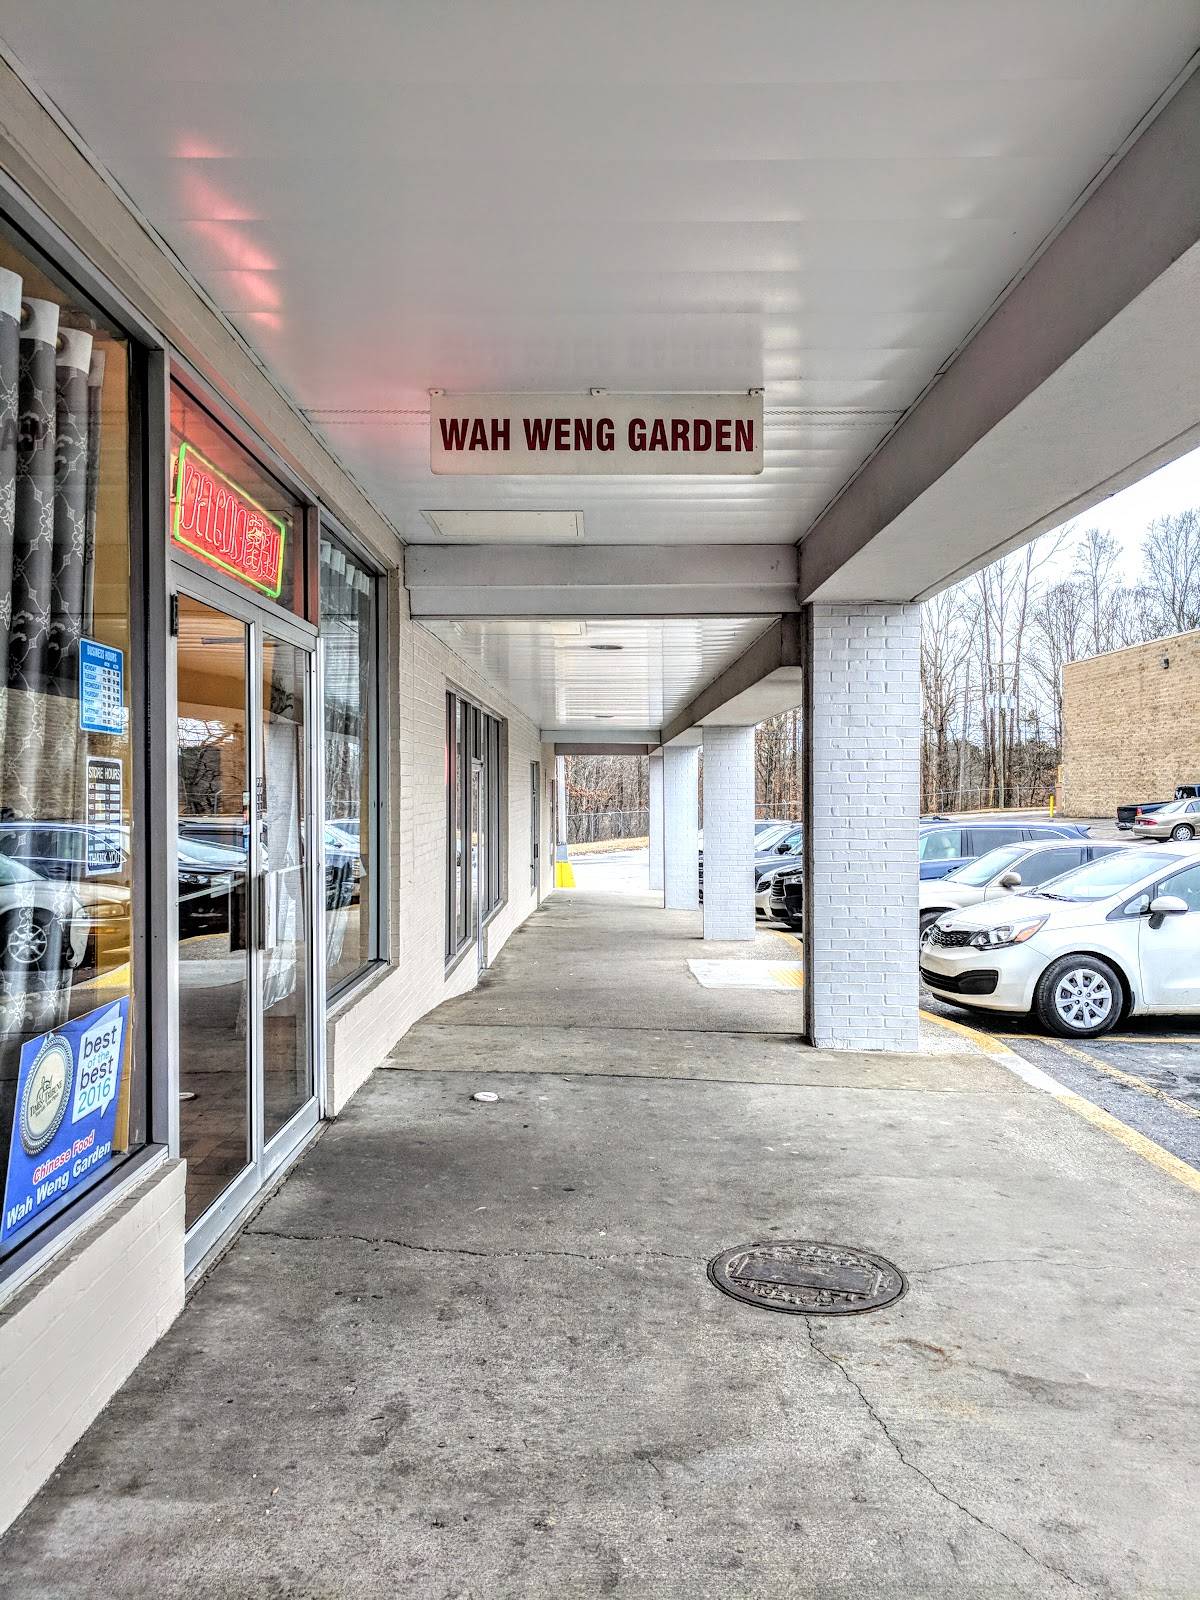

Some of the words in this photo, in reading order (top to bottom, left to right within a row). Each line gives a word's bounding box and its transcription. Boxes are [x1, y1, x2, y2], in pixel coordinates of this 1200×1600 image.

[439, 418, 511, 451] WAH
[522, 418, 615, 452] WENG
[627, 418, 755, 452] GARDEN
[88, 766, 104, 779] STORE
[104, 767, 120, 781] HOURS
[83, 1026, 117, 1059] best
[80, 1056, 114, 1091] best
[87, 1058, 97, 1069] of
[97, 1051, 110, 1065] the
[77, 1080, 111, 1114] 2016
[33, 1153, 71, 1184] Chinese
[72, 1129, 95, 1157] Food
[6, 1195, 33, 1230] Wah
[36, 1172, 69, 1206] Weng
[72, 1141, 111, 1178] Garden
